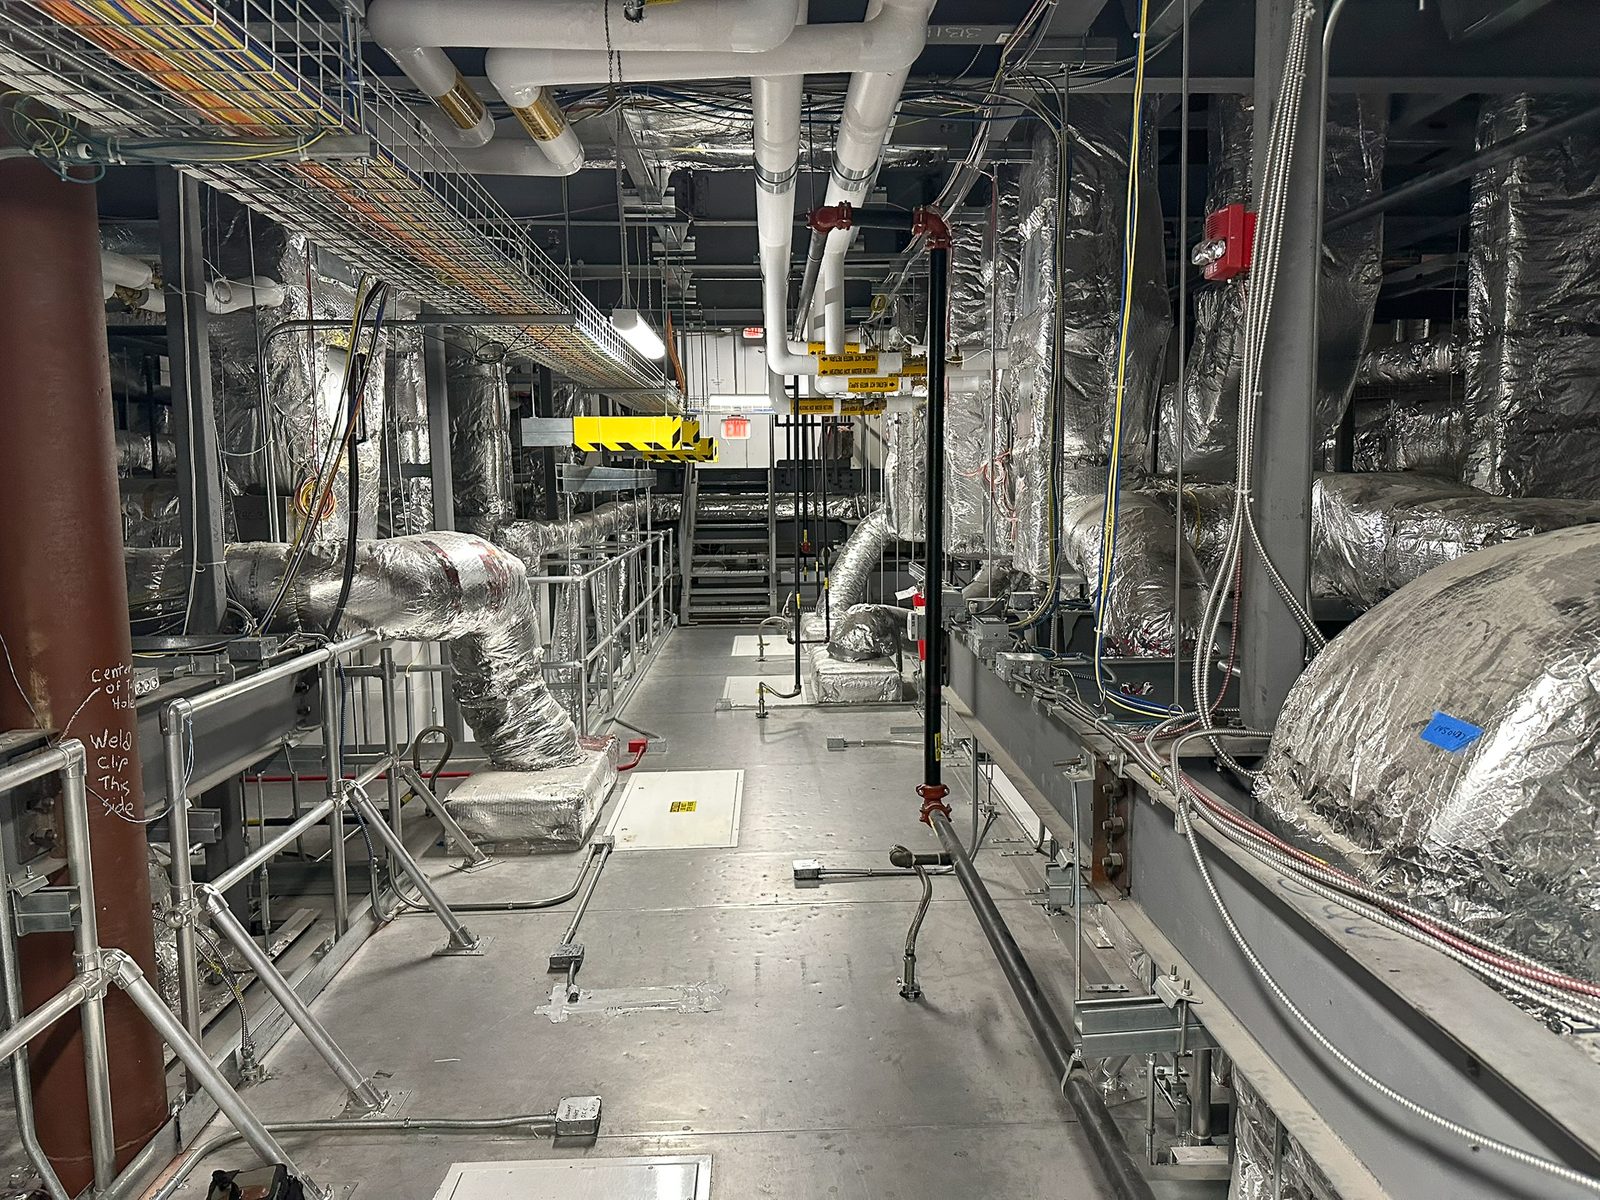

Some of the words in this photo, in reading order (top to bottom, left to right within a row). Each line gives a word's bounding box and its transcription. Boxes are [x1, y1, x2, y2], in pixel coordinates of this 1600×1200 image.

[1205, 262, 1218, 275] FIRE
[725, 420, 747, 437] EXIT
[105, 679, 121, 694] of
[89, 728, 132, 751] Weld
[97, 754, 129, 772] Clip
[97, 775, 130, 797] This
